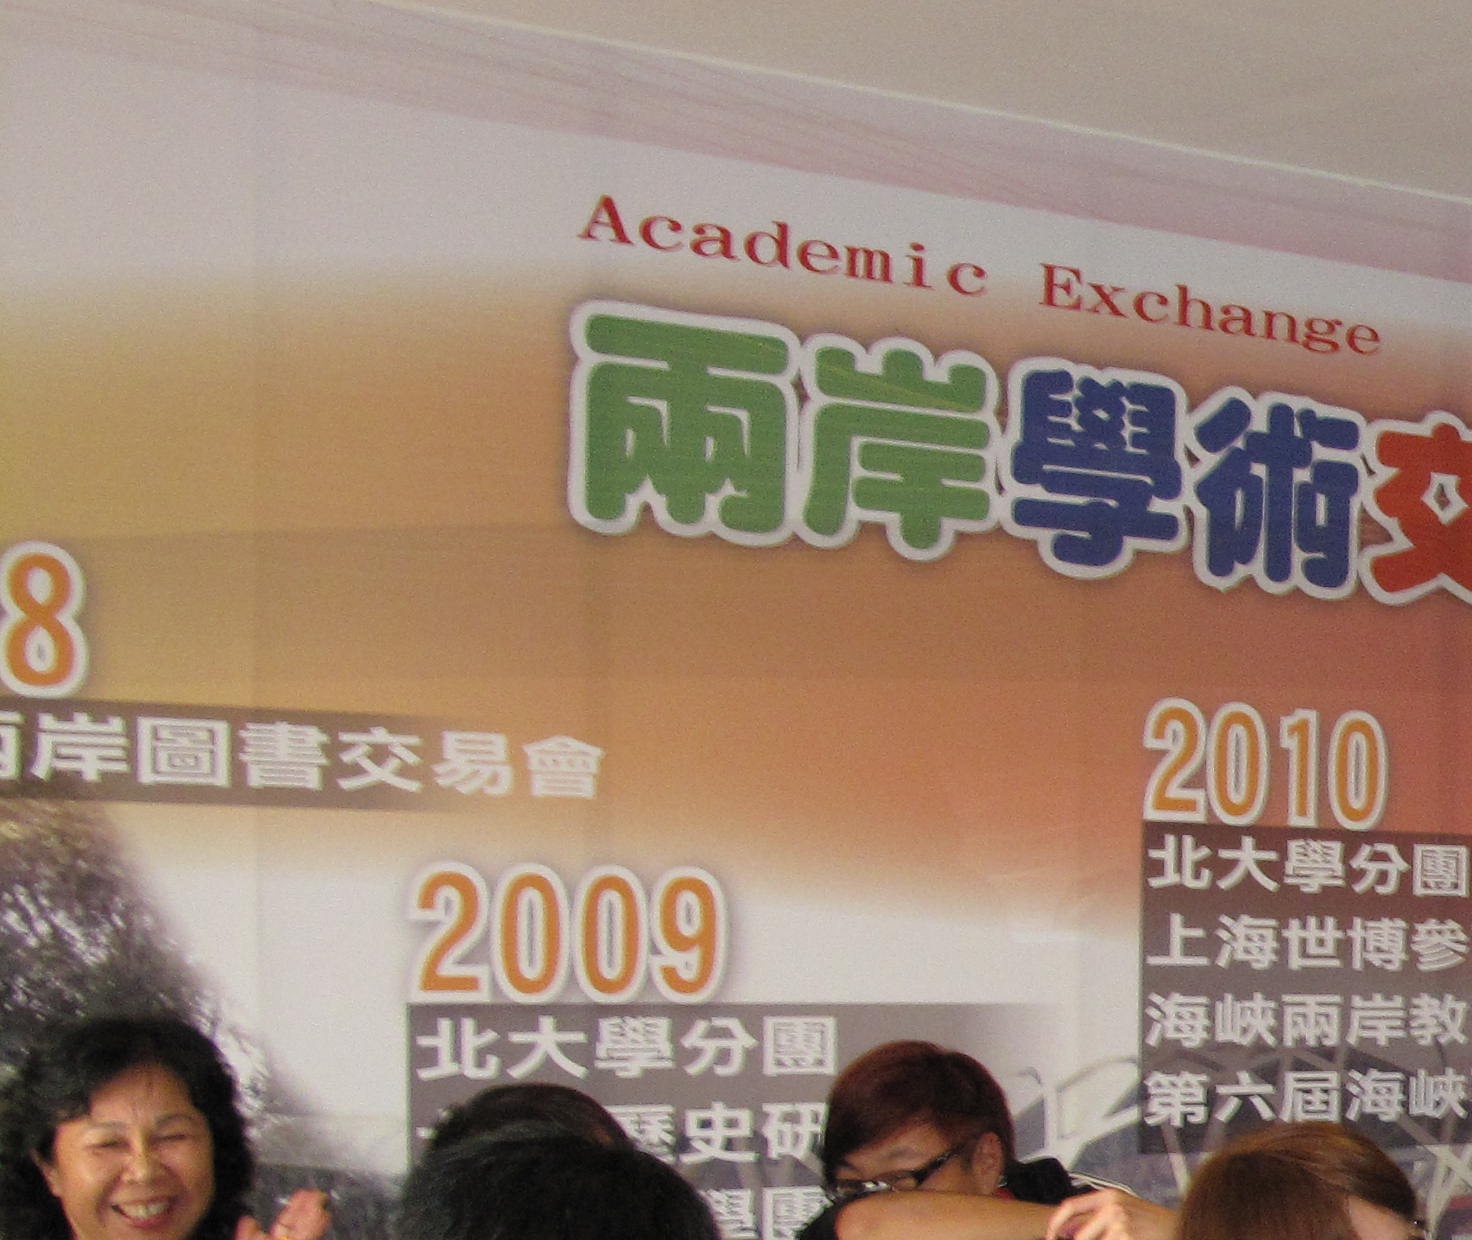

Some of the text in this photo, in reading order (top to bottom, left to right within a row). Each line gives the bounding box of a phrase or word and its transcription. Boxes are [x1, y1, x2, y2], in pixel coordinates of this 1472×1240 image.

[578, 194, 1381, 357] Academic Exchange
[0, 709, 604, 800] 岸圖書交易會
[1143, 698, 1390, 831] 2010
[1148, 834, 1470, 898] 北大學分團
[410, 861, 729, 1003] 2009
[415, 1014, 837, 1081] 北大學分團
